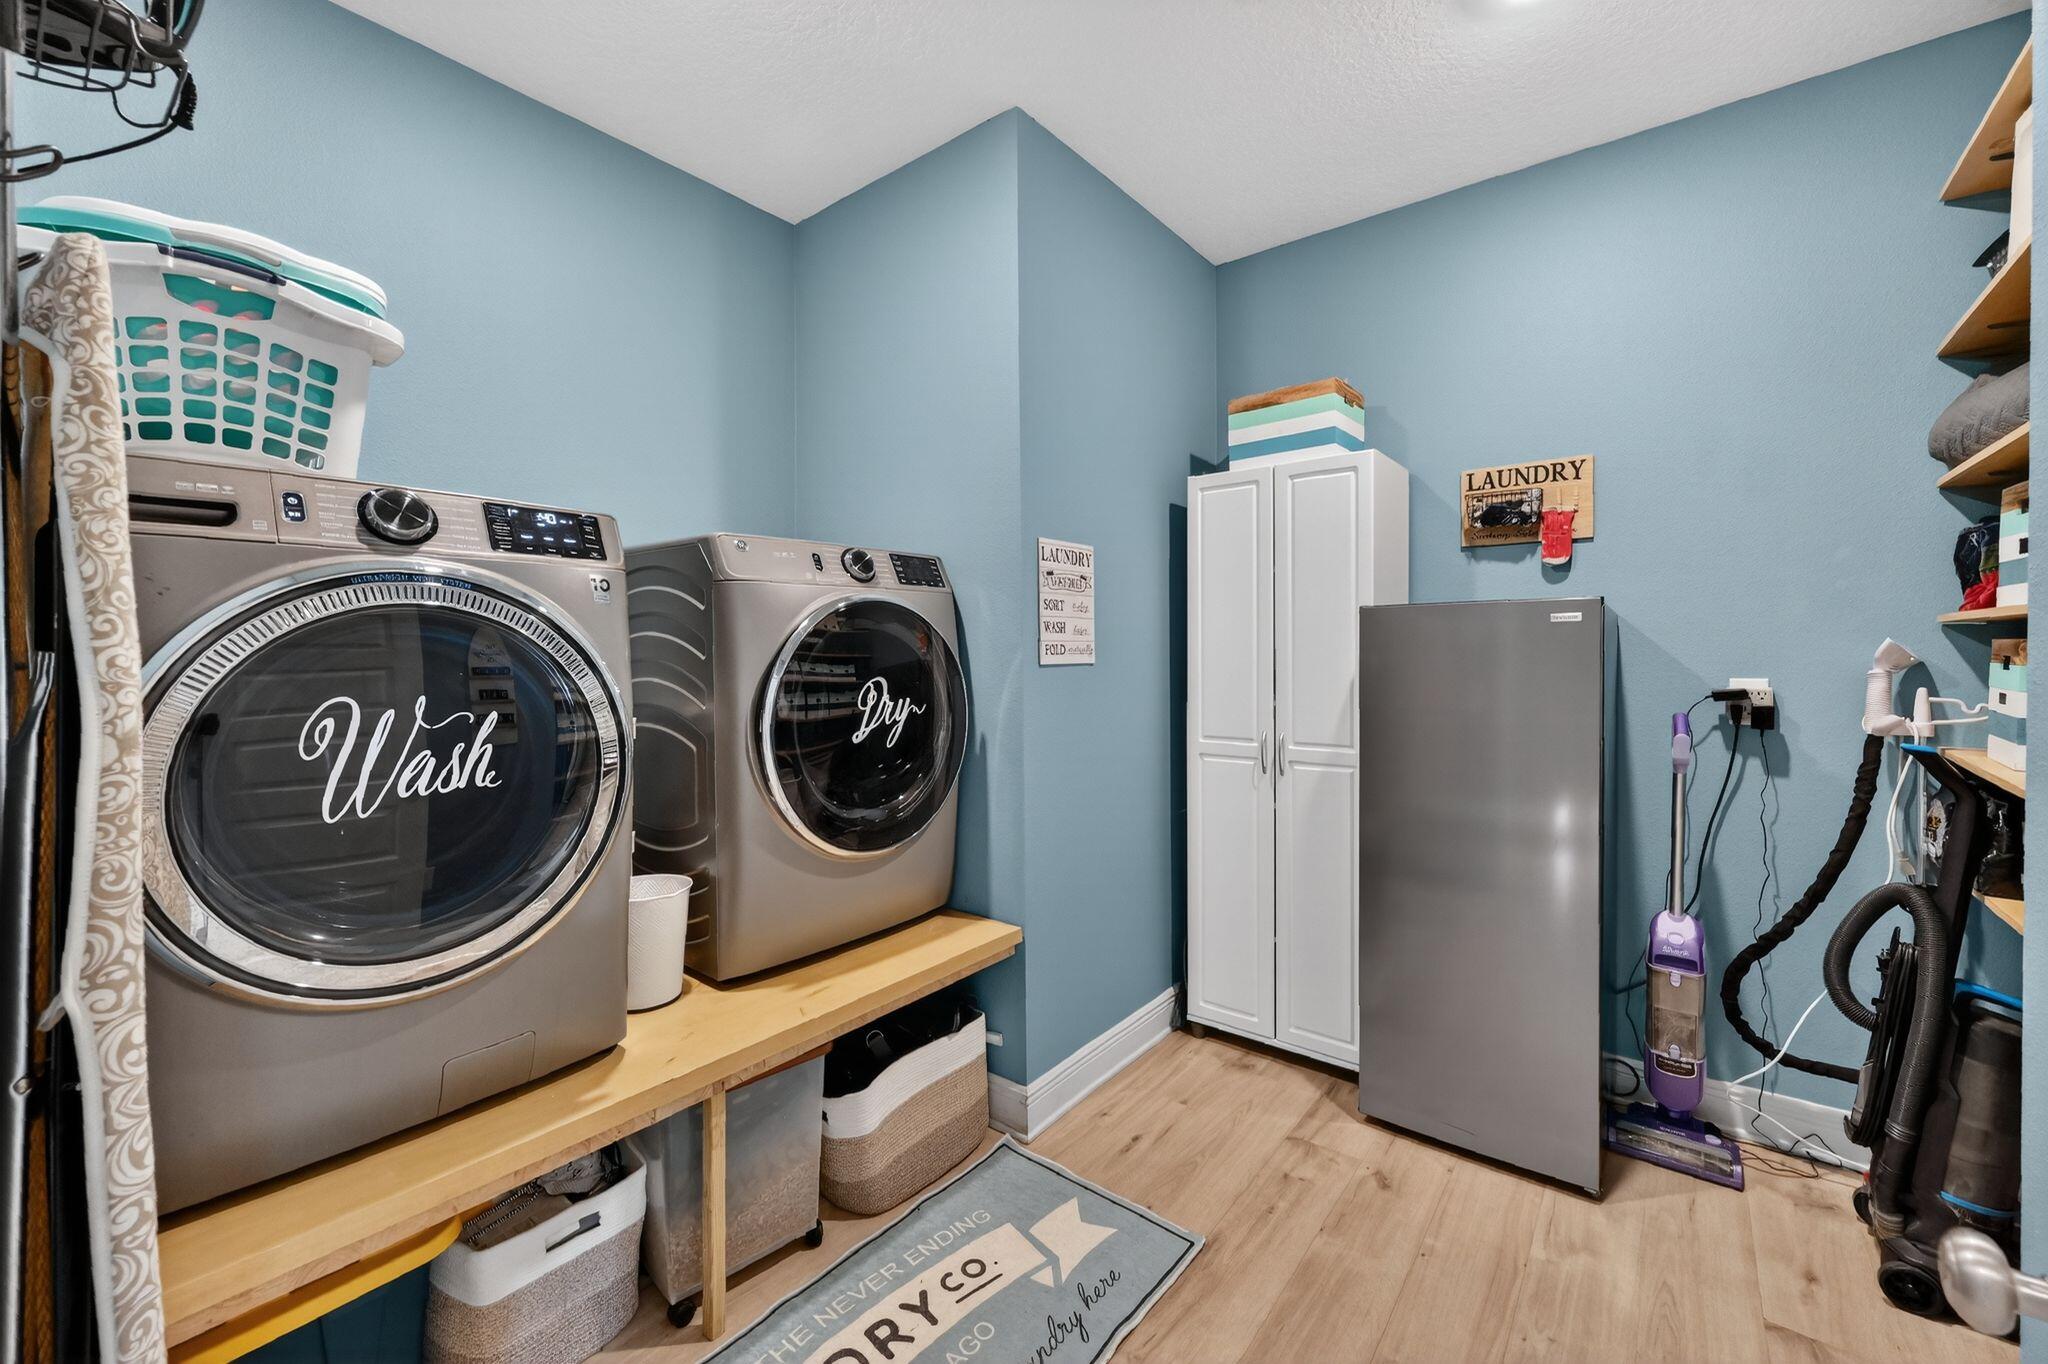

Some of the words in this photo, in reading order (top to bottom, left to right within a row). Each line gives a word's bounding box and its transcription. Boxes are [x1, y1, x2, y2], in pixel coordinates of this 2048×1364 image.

[1466, 458, 1587, 492] LAUNDRY
[1041, 546, 1092, 568] LAUNDRY
[1043, 598, 1065, 612] SORT
[1043, 621, 1066, 634] WASH
[1045, 644, 1066, 656] FOLD
[852, 676, 926, 748] Dry
[299, 695, 502, 824] Wash
[813, 1263, 904, 1328] NEVER
[903, 1209, 991, 1266] ENDING
[1077, 1269, 1121, 1311] here
